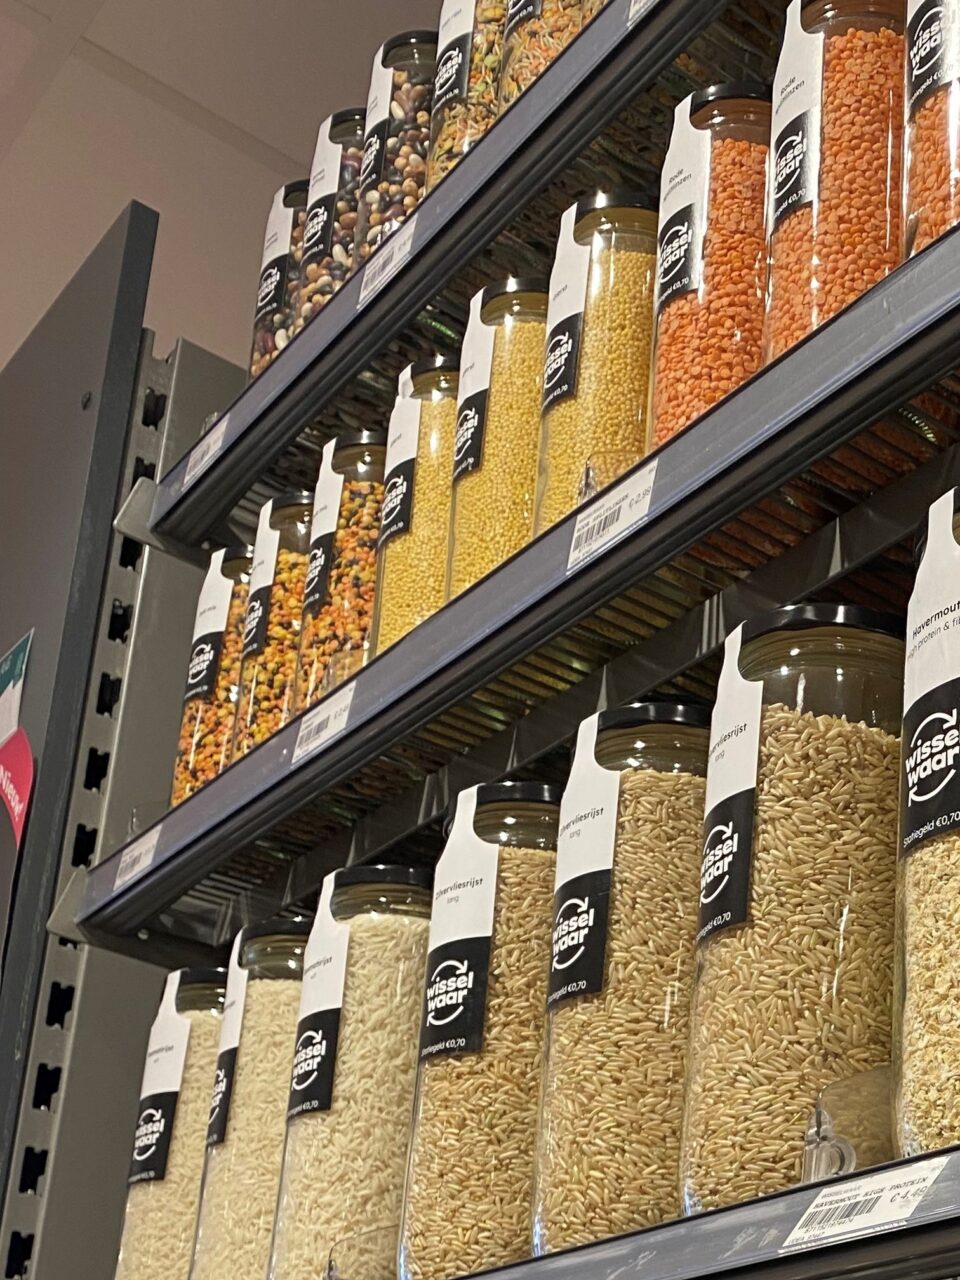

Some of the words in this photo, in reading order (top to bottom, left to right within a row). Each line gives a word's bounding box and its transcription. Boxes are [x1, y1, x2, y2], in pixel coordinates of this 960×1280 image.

[907, 746, 960, 789] waar
[426, 971, 475, 1000] wissel
[567, 979, 588, 994] €0,70
[427, 988, 469, 1013] waar
[445, 1037, 467, 1050] €0,70
